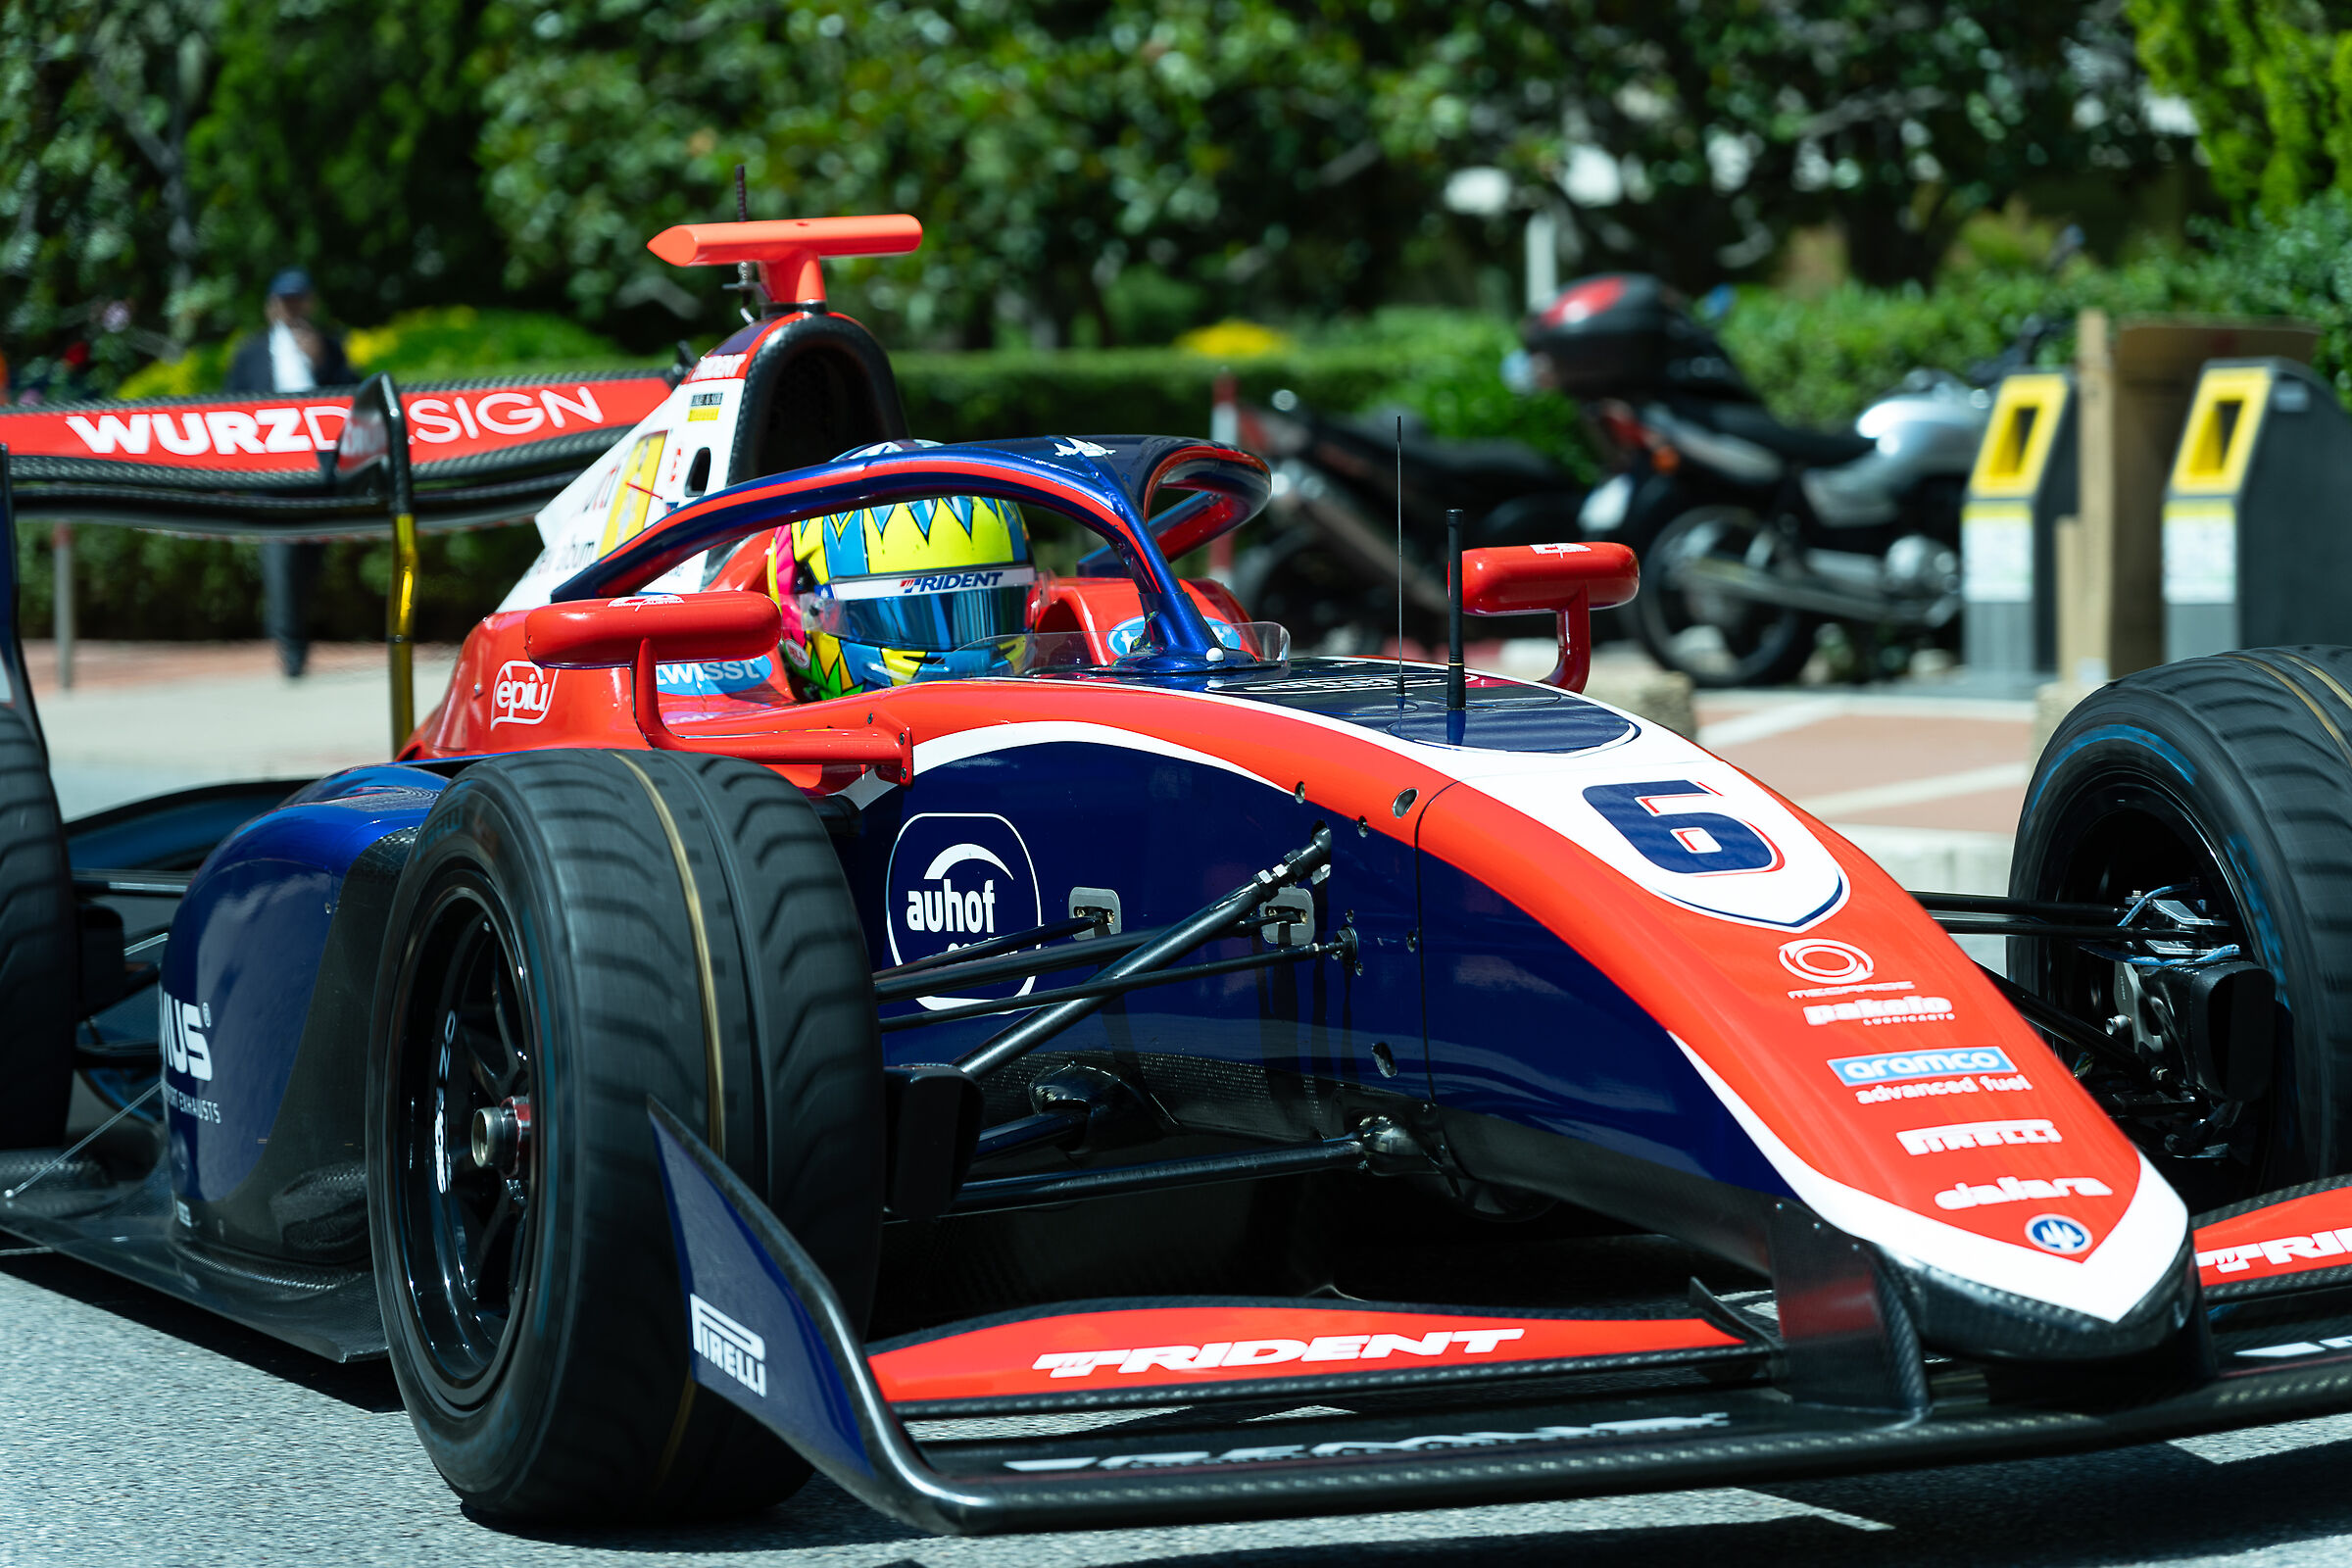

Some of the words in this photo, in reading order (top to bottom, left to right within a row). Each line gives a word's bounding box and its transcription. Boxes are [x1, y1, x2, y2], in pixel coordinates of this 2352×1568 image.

[900, 571, 1004, 594] TRIDENT
[1582, 779, 1785, 877] 6
[906, 878, 996, 933] auhof
[1844, 1052, 2000, 1079] aramco
[1855, 1076, 1980, 1104] advanced
[1979, 1074, 2034, 1092] fuel
[1895, 1119, 2063, 1155] PIRELLI
[690, 1293, 767, 1398] PIRELLI
[1032, 1328, 1525, 1378] TRIDENT
